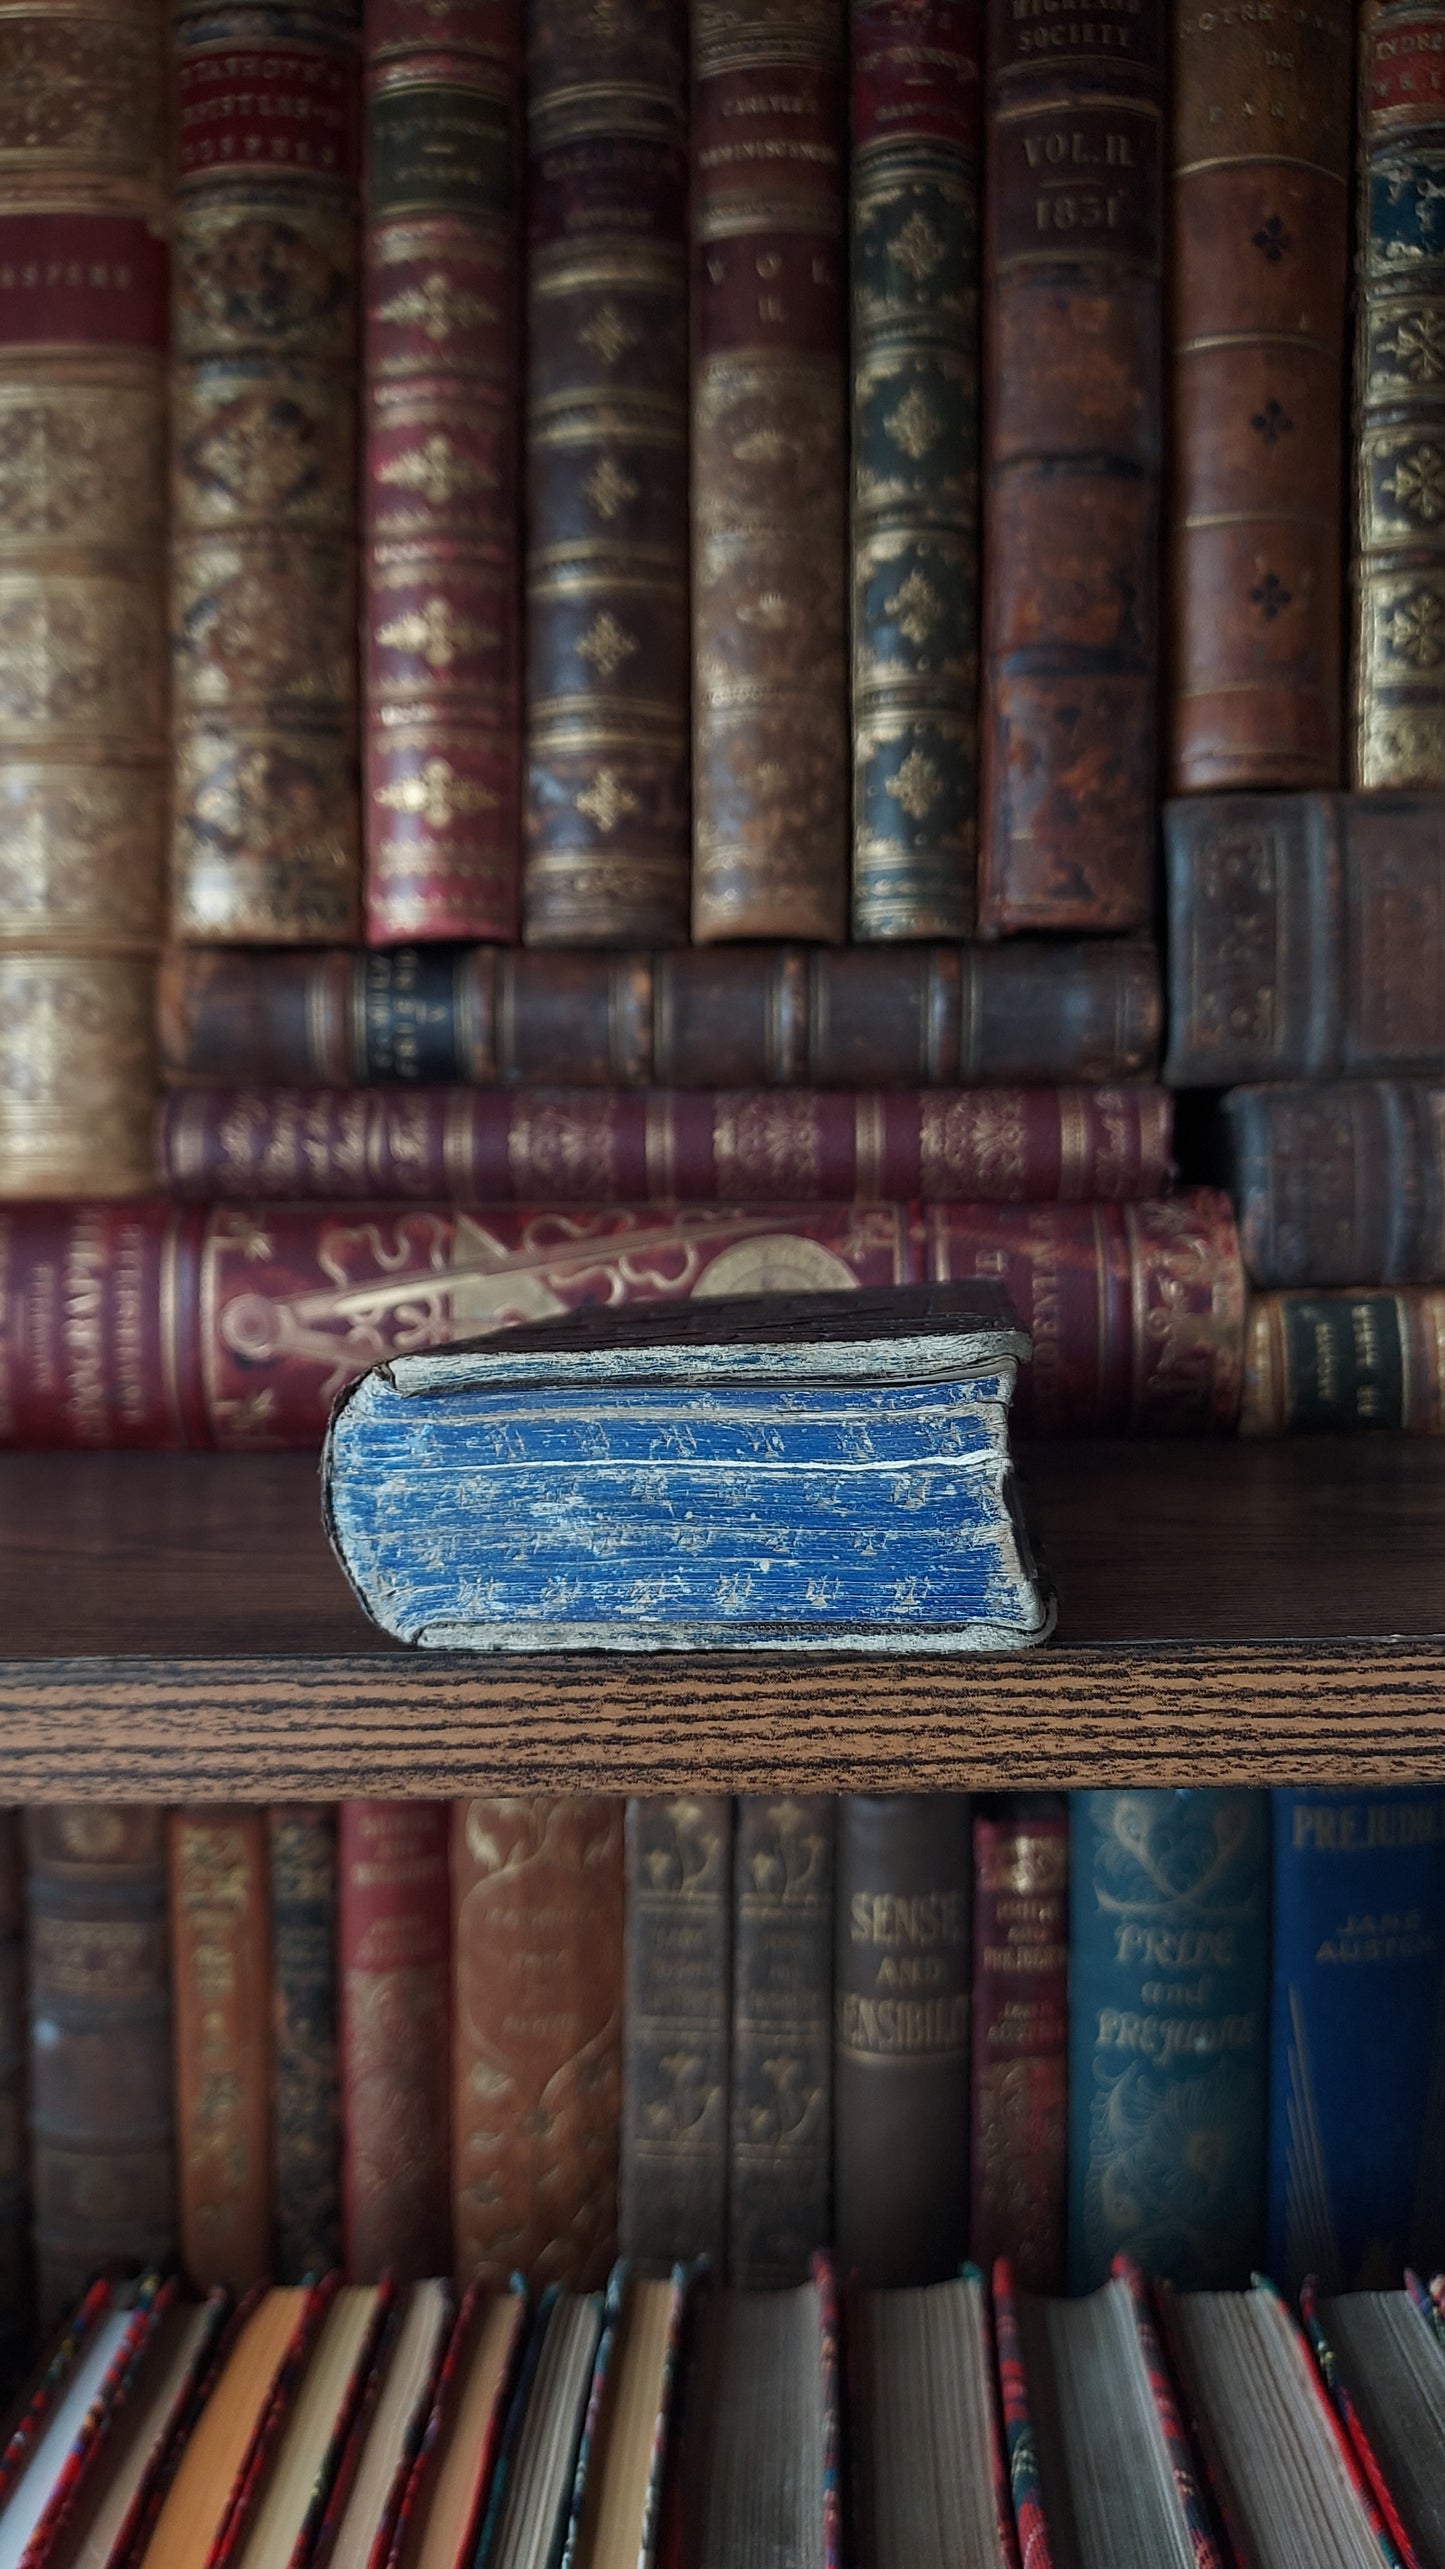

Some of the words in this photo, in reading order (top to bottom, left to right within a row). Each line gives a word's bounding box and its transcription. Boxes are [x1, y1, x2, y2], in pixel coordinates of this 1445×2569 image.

[1018, 23, 1129, 51] SOCIETY
[1264, 49, 1295, 69] DE
[1036, 195, 1122, 231] 1831
[875, 1955, 947, 1988] AND
